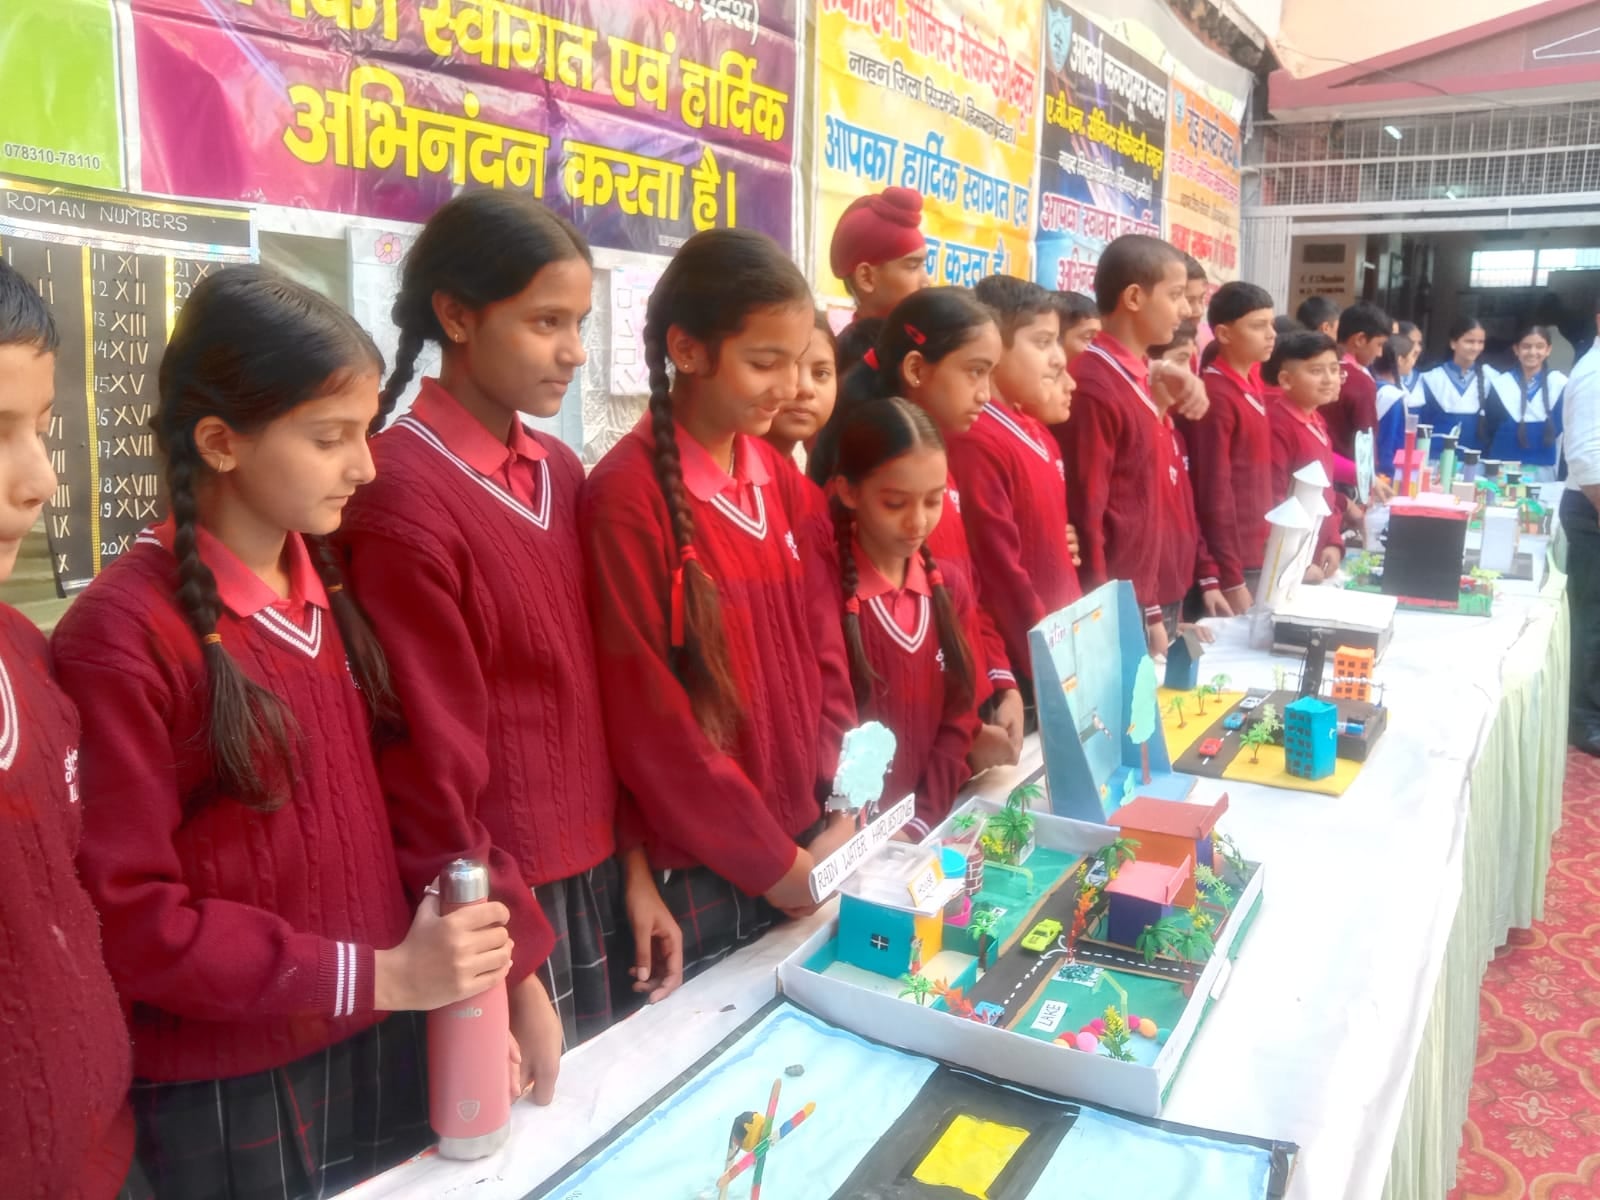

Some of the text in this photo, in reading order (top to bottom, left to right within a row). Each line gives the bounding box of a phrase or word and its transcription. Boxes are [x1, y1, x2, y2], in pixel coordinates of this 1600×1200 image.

[420, 0, 597, 91] स्वागत
[607, 31, 672, 111] एवं
[680, 50, 788, 141] हार्दिक
[849, 51, 889, 85] नाहन
[892, 60, 922, 100] जिला
[4, 143, 101, 170] 078310-78110
[283, 66, 549, 199] अभिनंदन
[563, 140, 685, 221] करता
[825, 115, 898, 186] आपका
[901, 131, 961, 203] हार्दिक
[963, 166, 1011, 221] स्वागत
[7, 192, 188, 232] ROMAN NUMBERS
[118, 254, 140, 279] XI
[174, 260, 190, 278] 21
[92, 279, 147, 305] 12 XII
[94, 311, 147, 338] 13 XIII
[109, 340, 149, 366] XIV
[110, 373, 146, 396] XV
[113, 434, 153, 457] XVII
[113, 473, 158, 497] XVIII
[115, 497, 159, 521] XIX
[100, 542, 119, 555] 20
[818, 860, 839, 890] RAIN
[841, 834, 868, 870] WATER
[1040, 1003, 1062, 1028] LAKE
